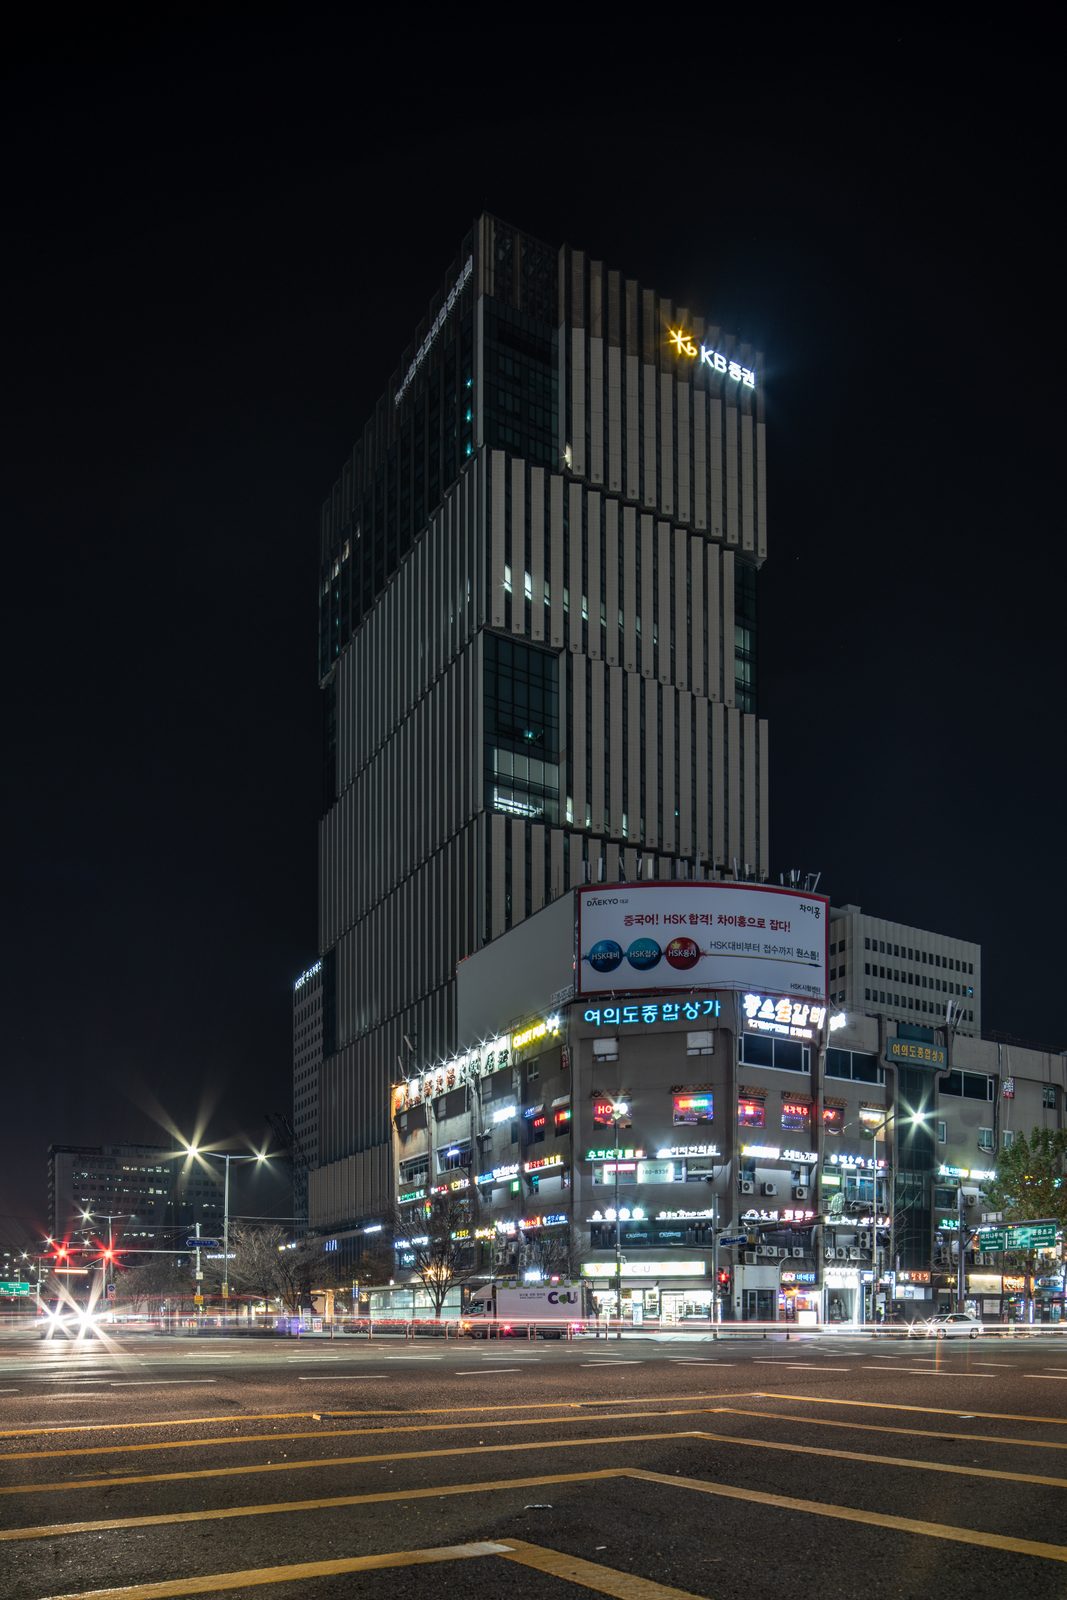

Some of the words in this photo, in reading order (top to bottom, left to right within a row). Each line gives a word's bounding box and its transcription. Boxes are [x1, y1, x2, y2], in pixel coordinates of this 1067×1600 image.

[701, 345, 755, 389] KB증권
[586, 897, 619, 907] DAEKYO
[799, 904, 821, 919] 차이홍
[624, 914, 659, 927] 중국어!
[663, 914, 687, 925] HSK
[688, 913, 713, 926] 합격!
[717, 915, 766, 930] 차이홍으로
[769, 919, 791, 933] 잡다!
[710, 940, 760, 954] HSK대비부터
[763, 943, 794, 957] 접수까지
[584, 1000, 721, 1026] 여의도종합상가
[892, 1043, 944, 1064] 여의도종합상가
[548, 1291, 578, 1304] CU
